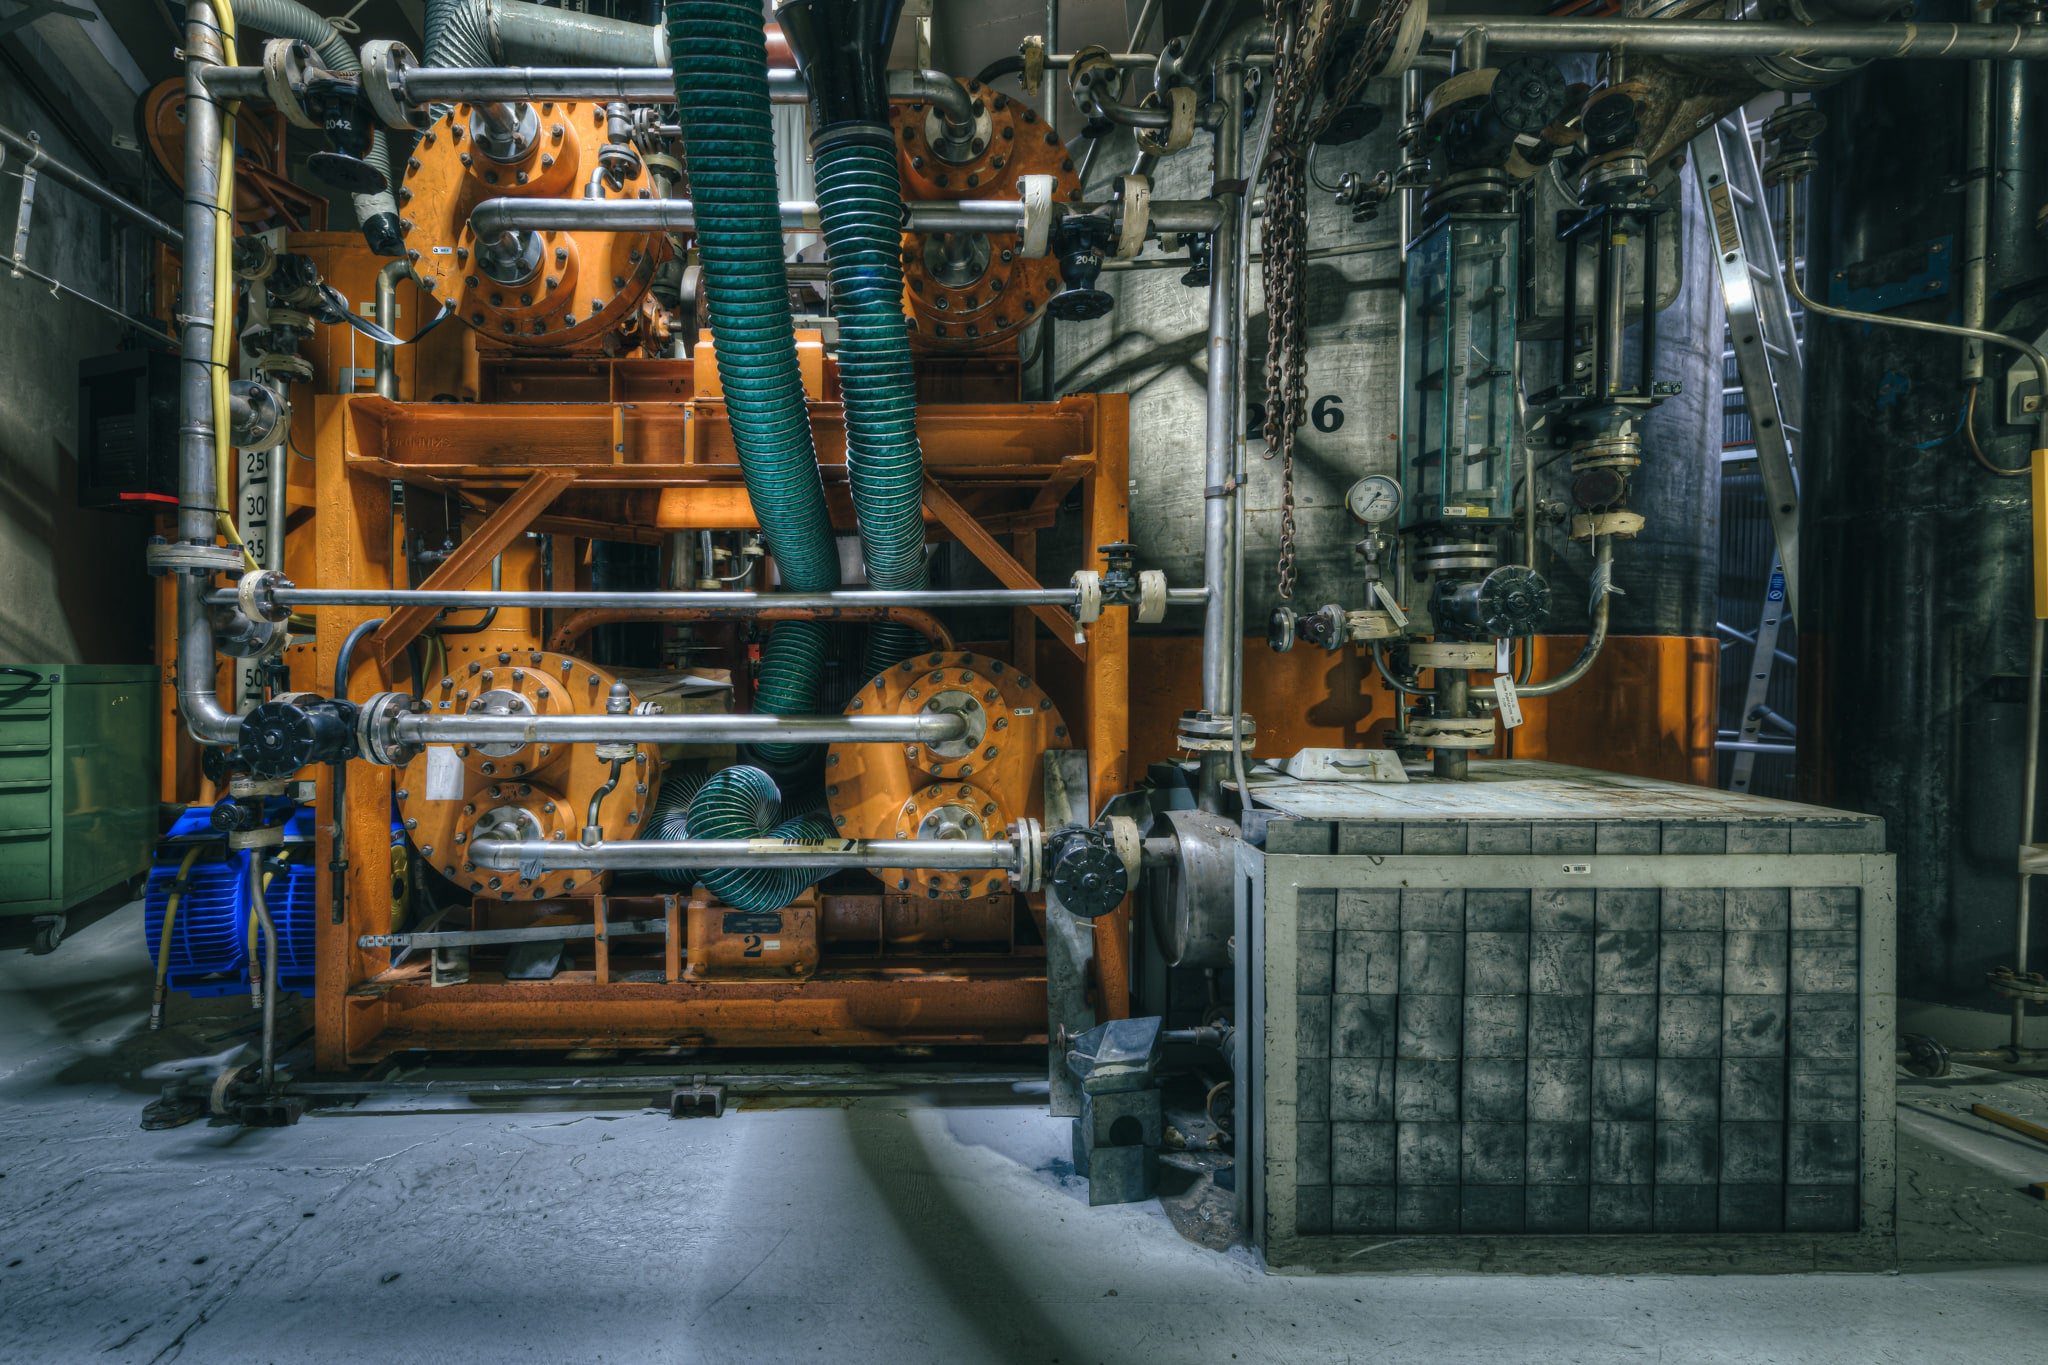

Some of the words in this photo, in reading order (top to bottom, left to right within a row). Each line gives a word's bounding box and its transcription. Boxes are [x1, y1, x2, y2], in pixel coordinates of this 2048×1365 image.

[326, 119, 352, 131] 2042
[1075, 255, 1097, 266] 2041
[247, 452, 268, 473] 25
[247, 495, 267, 516] 30
[782, 838, 824, 847] HELIUM
[744, 935, 762, 957] 2
